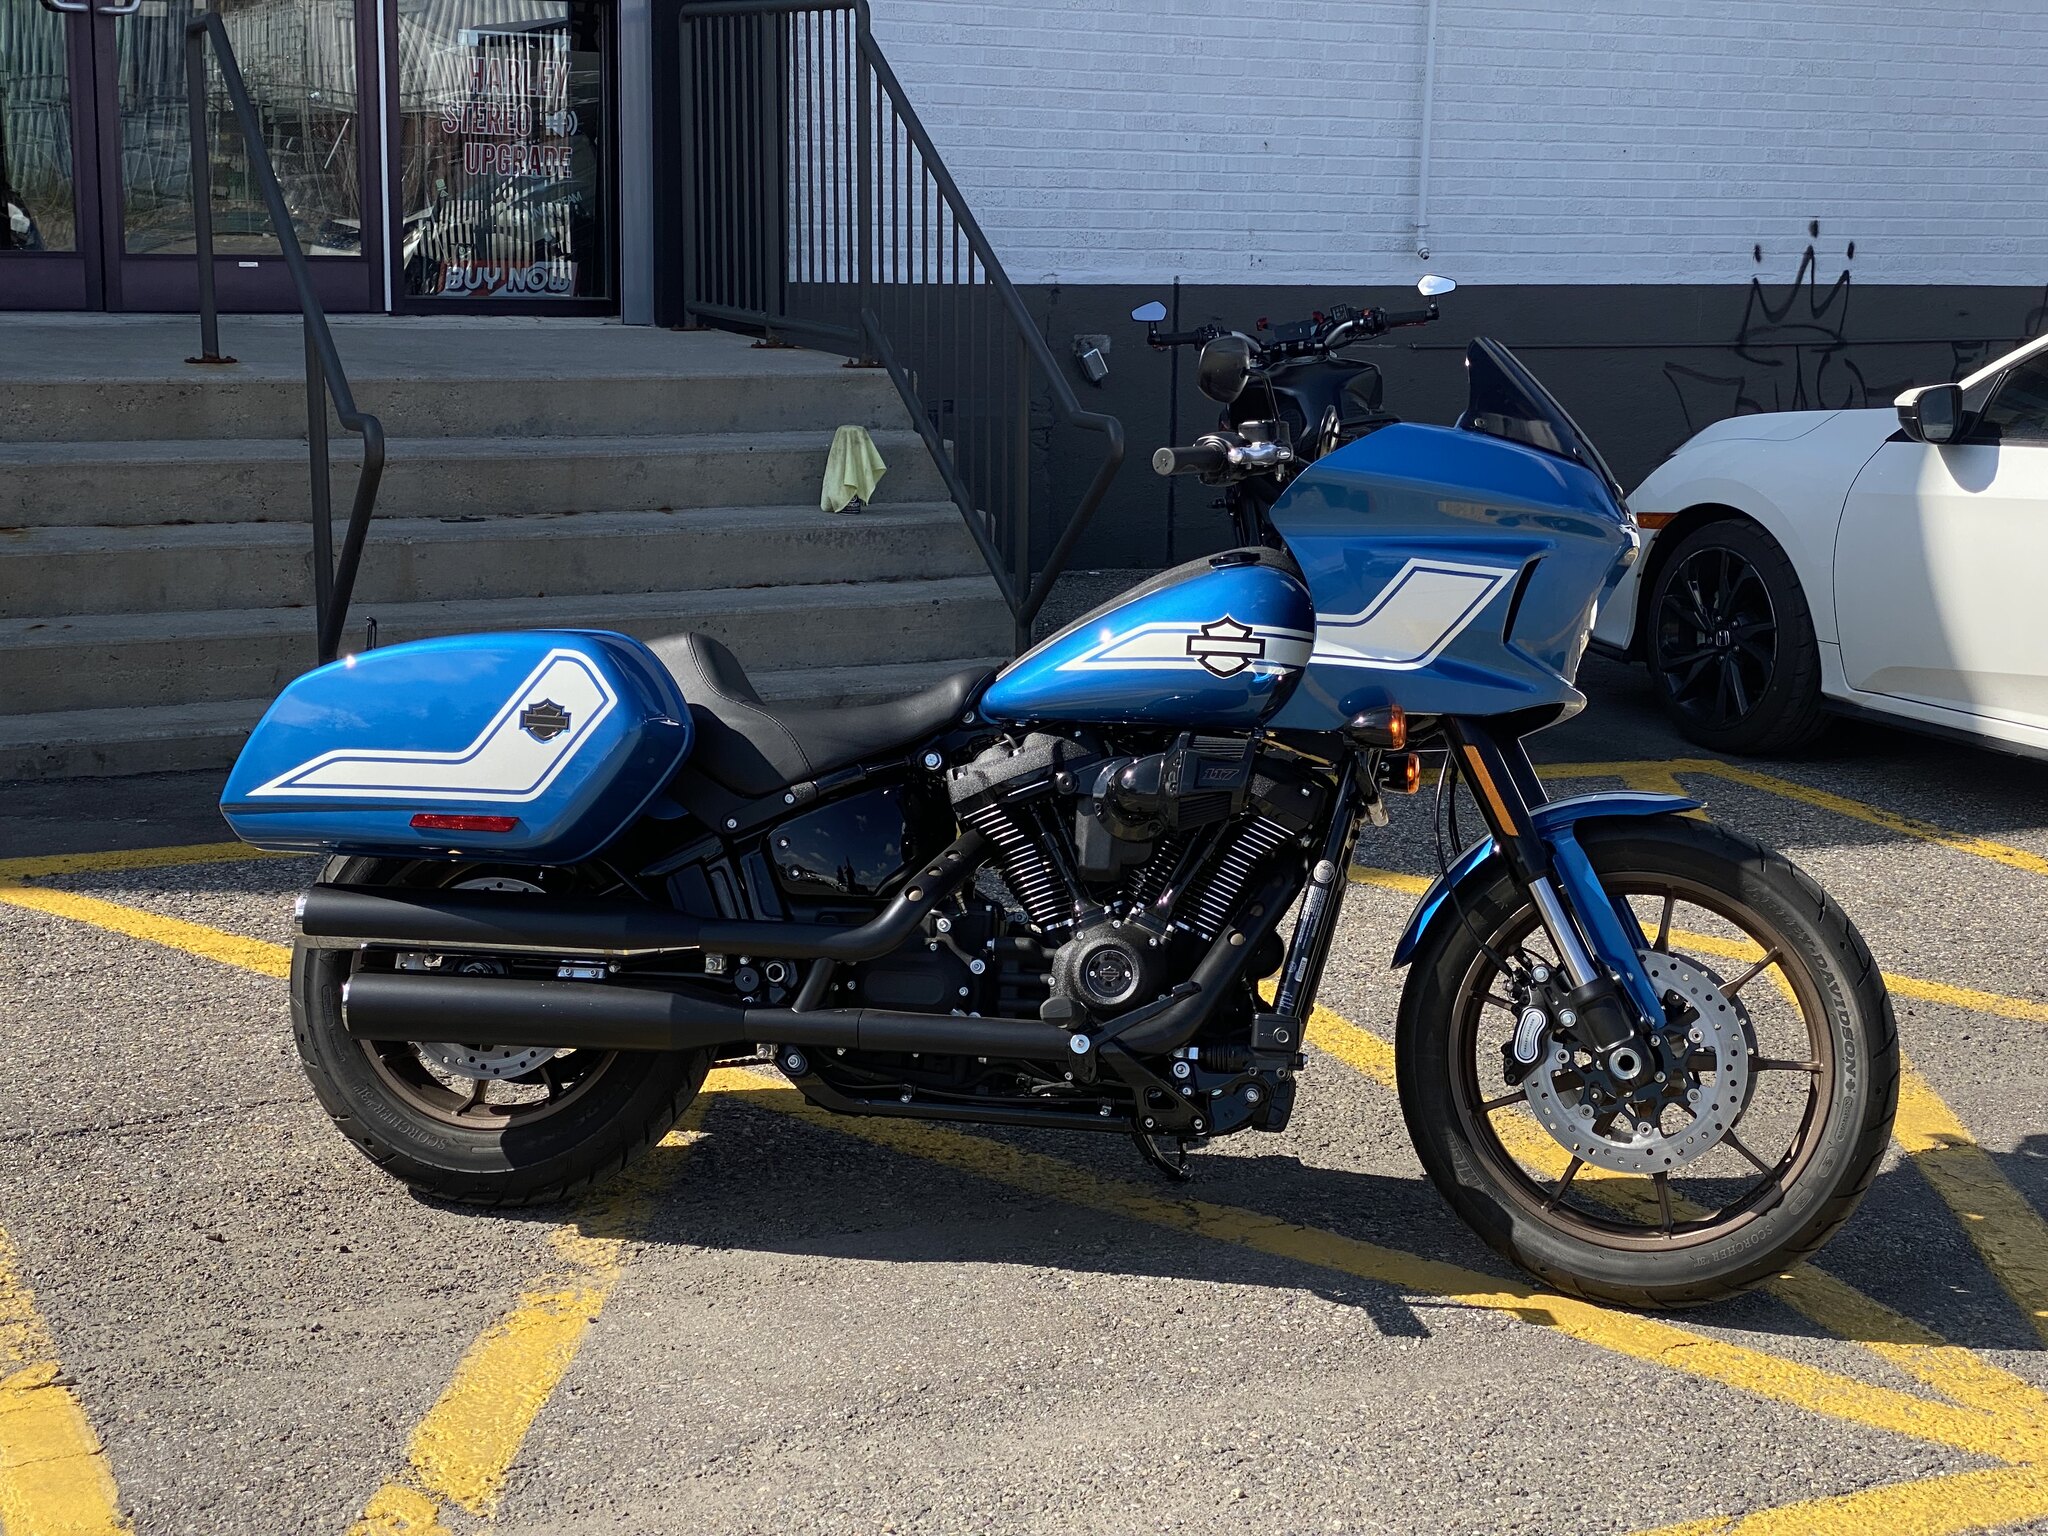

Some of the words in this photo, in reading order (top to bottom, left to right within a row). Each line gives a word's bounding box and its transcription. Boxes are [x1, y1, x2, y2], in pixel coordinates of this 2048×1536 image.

[466, 57, 572, 98] HARLEY
[441, 100, 533, 136] STEREO
[464, 142, 572, 178] UPGRADE
[446, 267, 500, 291] BUY
[507, 267, 570, 292] NOW
[1712, 1225, 1773, 1258] SCORCHER
